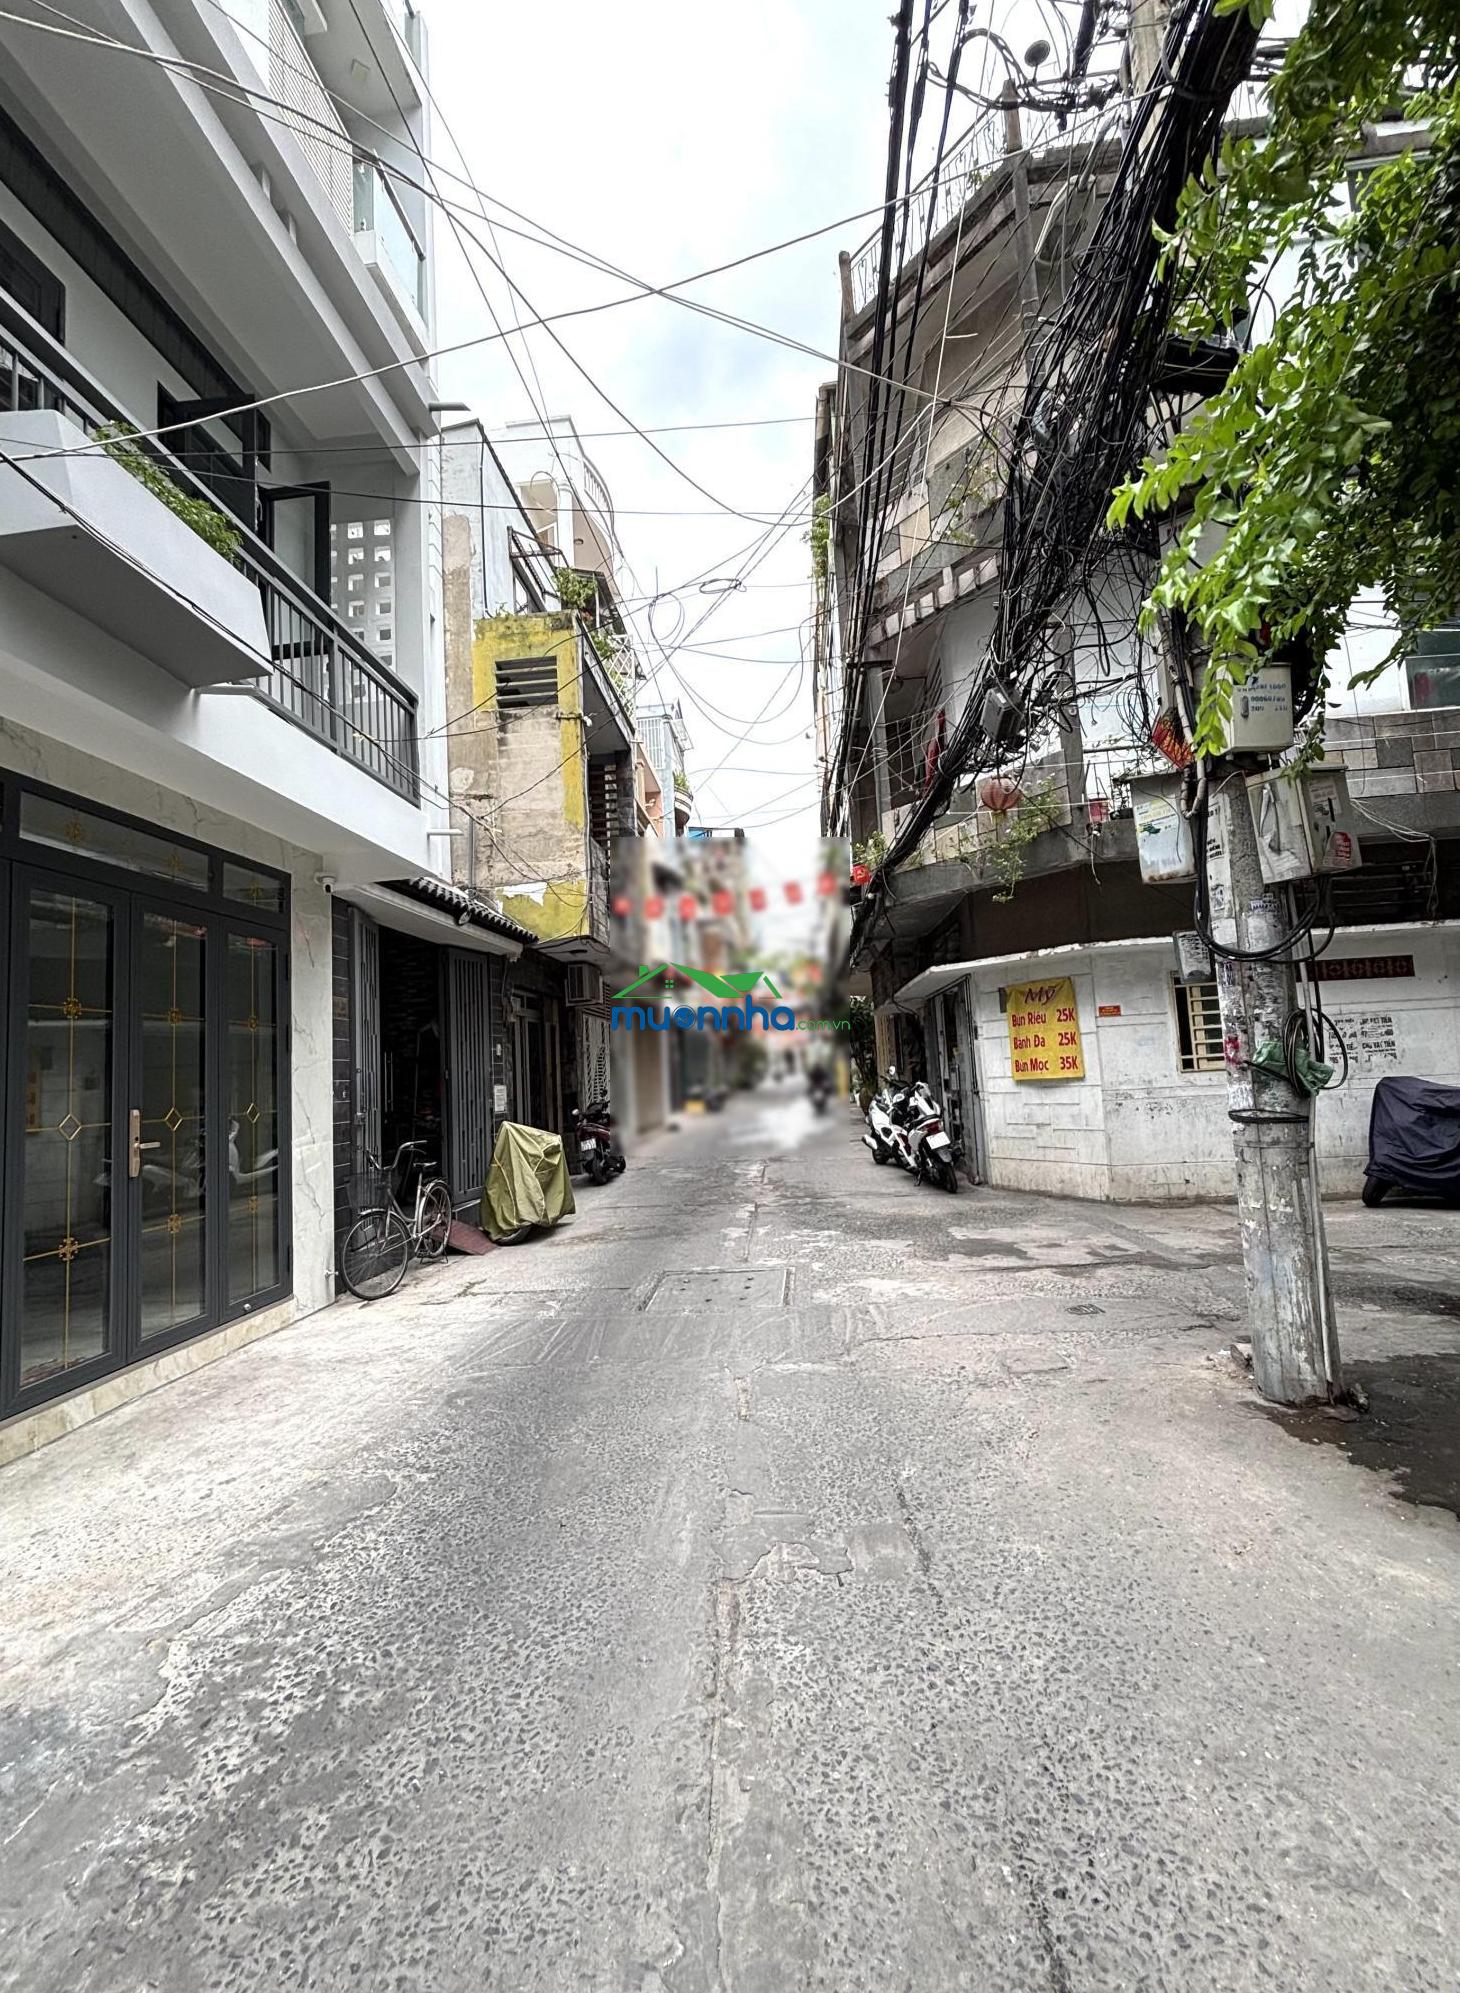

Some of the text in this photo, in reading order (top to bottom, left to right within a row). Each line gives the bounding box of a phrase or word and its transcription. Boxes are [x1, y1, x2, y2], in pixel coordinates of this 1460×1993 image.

[1056, 1008, 1076, 1023] 25K
[1058, 1032, 1077, 1046] 25K
[1060, 1056, 1079, 1070] 35K
